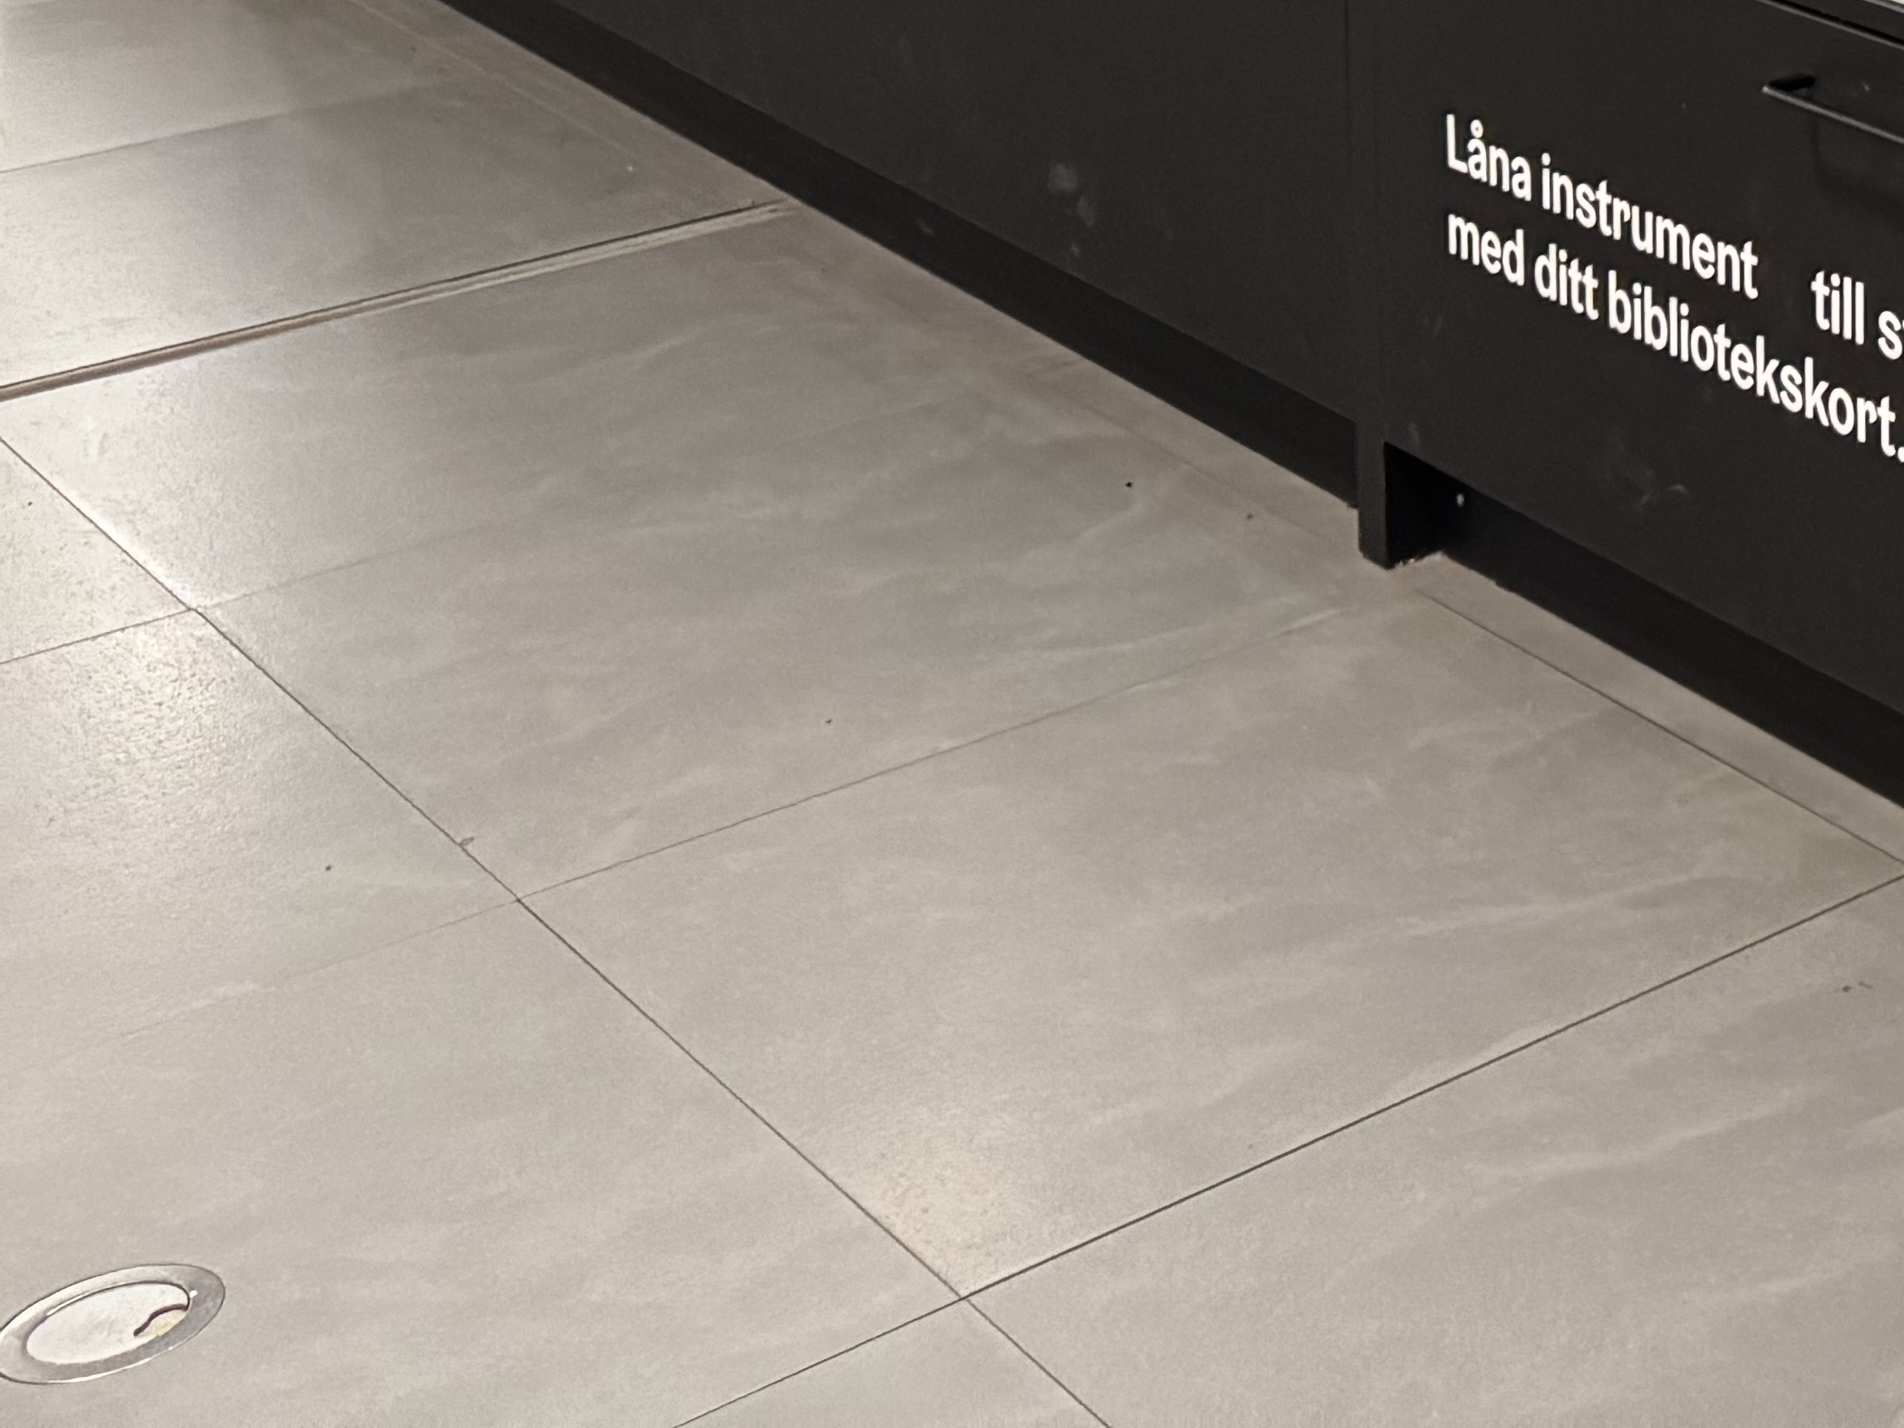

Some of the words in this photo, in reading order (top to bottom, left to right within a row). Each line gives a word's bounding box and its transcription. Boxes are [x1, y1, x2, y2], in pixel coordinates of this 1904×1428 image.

[1446, 114, 1532, 202] Låna
[1541, 152, 1759, 300] instrument
[1810, 270, 1865, 345] till
[1448, 213, 1525, 286] med
[1534, 243, 1599, 321] ditt
